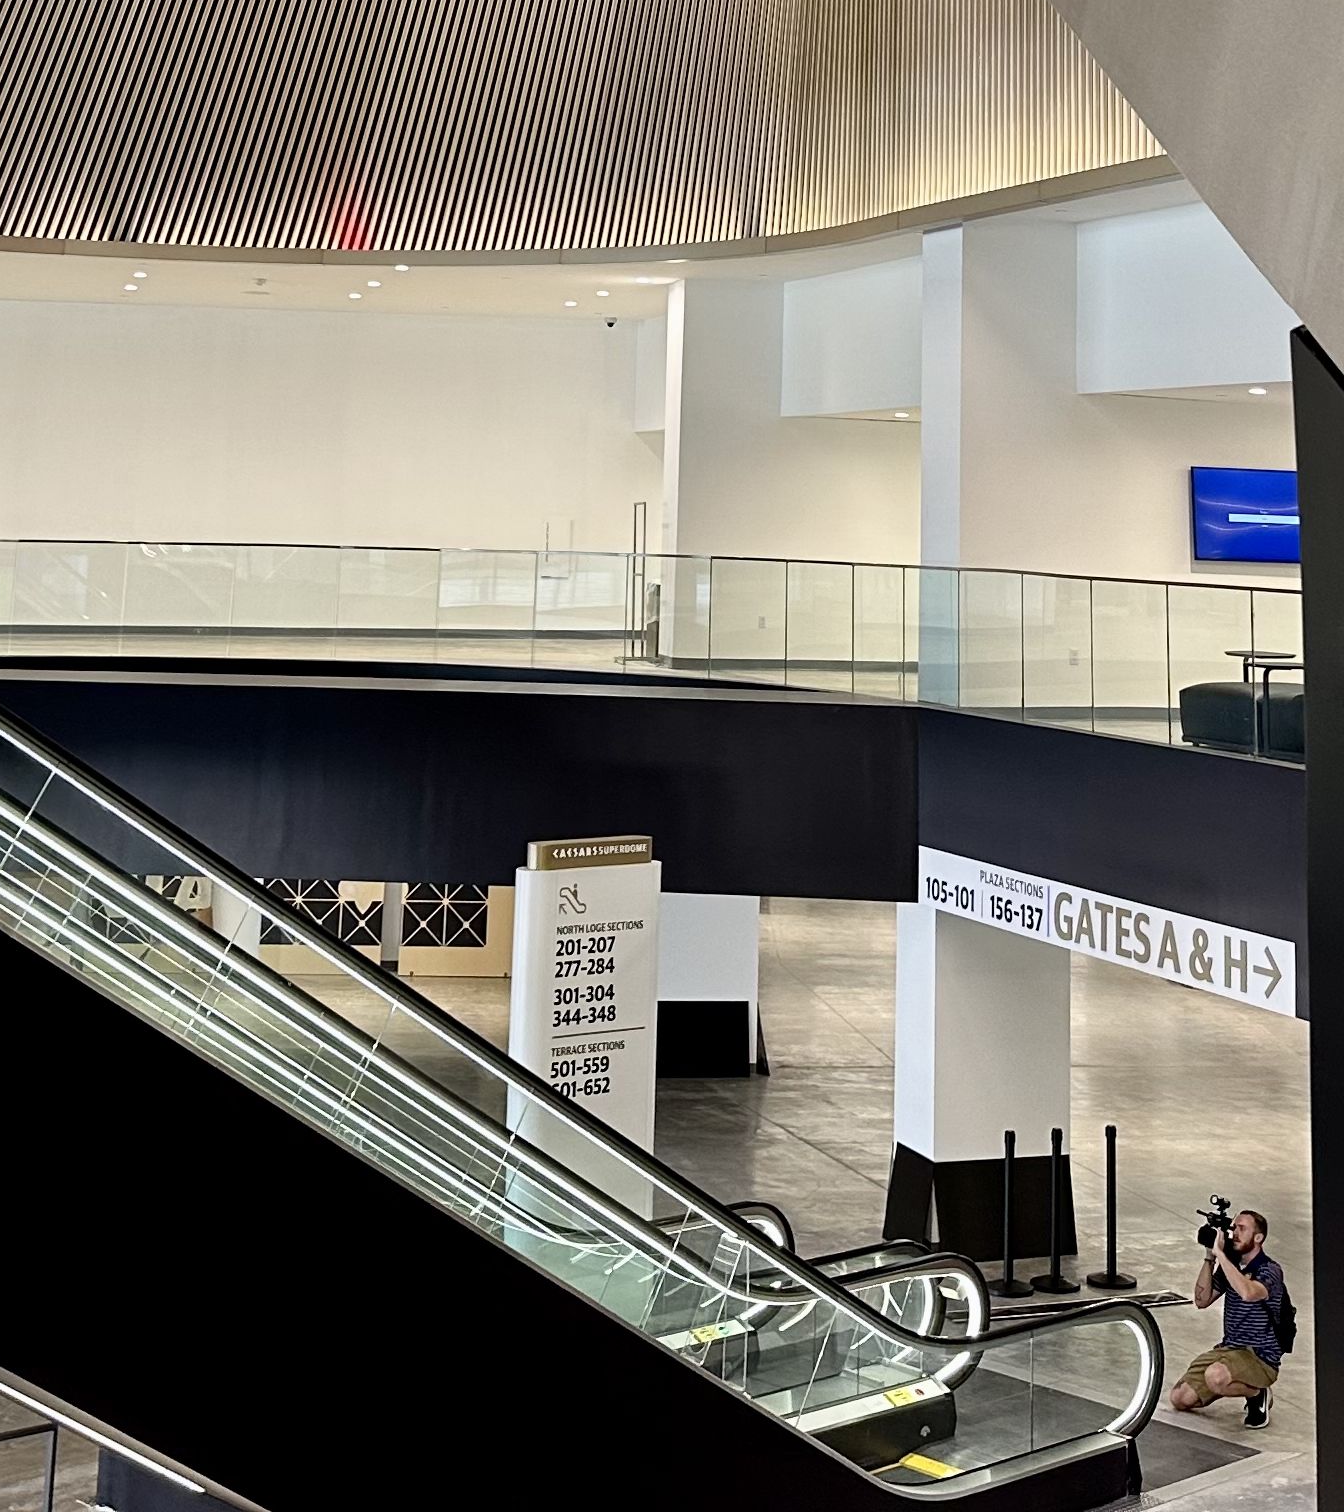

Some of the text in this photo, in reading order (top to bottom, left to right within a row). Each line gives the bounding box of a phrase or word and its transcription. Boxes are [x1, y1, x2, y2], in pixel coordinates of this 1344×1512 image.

[552, 843, 648, 859] CAESARS SUPERDOME
[979, 869, 1044, 899] PLAZA SECTIONS
[925, 876, 1043, 932] 105-101 156-137
[556, 919, 644, 935] NORTH LOGE SECTIONS
[555, 935, 616, 957] 201-207
[1054, 891, 1248, 994] GATES A & H
[554, 956, 616, 978] 277-284
[553, 983, 615, 1006] 301-304
[552, 1004, 616, 1028] 344-348
[551, 1040, 625, 1057] TERRACE SECTIONS
[550, 1055, 610, 1079] 501-559
[551, 1076, 610, 1098] 01-652
